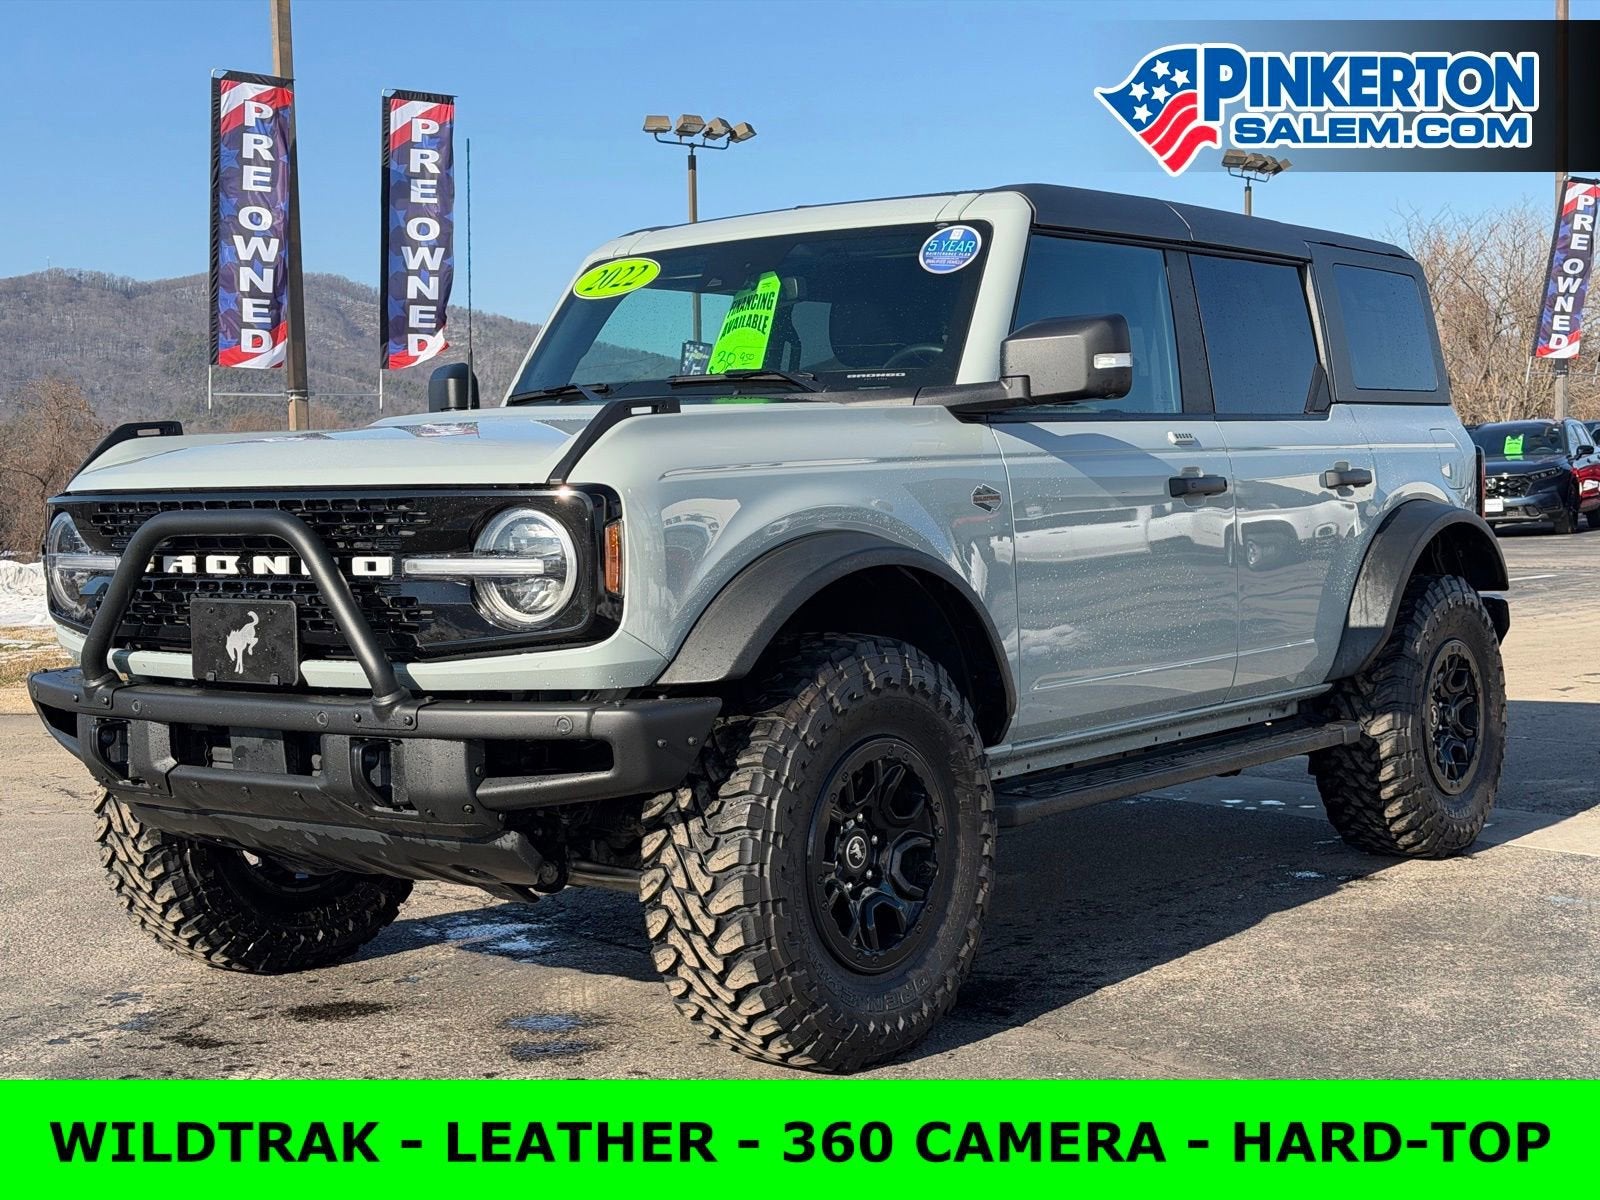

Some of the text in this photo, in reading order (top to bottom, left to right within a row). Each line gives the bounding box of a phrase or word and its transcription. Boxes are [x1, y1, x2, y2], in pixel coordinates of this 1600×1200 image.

[232, 100, 280, 354] PRE OWNED
[400, 117, 446, 357] PRE OWNED
[928, 240, 977, 253] 5 YEAR
[582, 264, 650, 293] 2022
[1548, 194, 1596, 350] PRE OWNED
[726, 291, 776, 319] FINANCING
[719, 313, 770, 341] AVAILABLE
[144, 555, 394, 576] RONO
